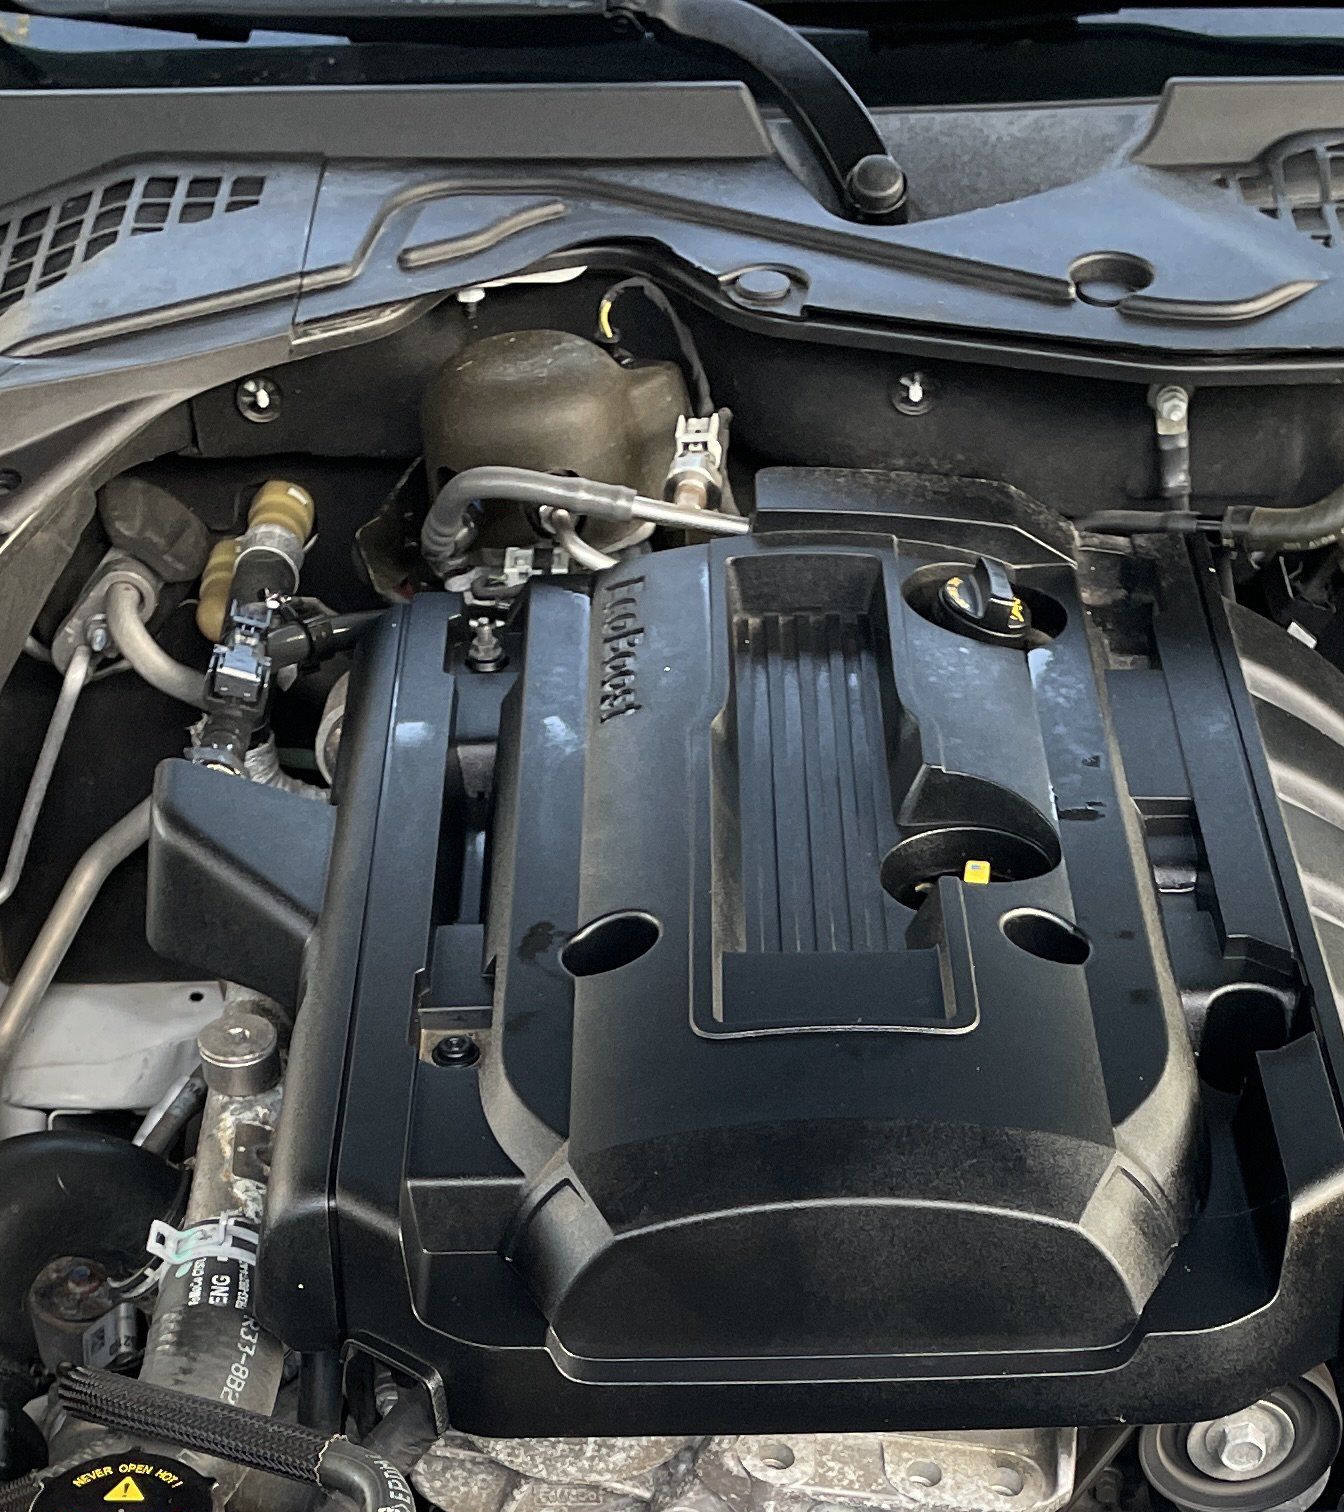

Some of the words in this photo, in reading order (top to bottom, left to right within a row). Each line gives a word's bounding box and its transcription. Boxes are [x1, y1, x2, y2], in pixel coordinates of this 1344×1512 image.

[208, 1274, 231, 1307] ENG
[72, 1466, 113, 1487] NEVER
[118, 1463, 154, 1475] OPEN
[155, 1469, 184, 1489] HOT!
